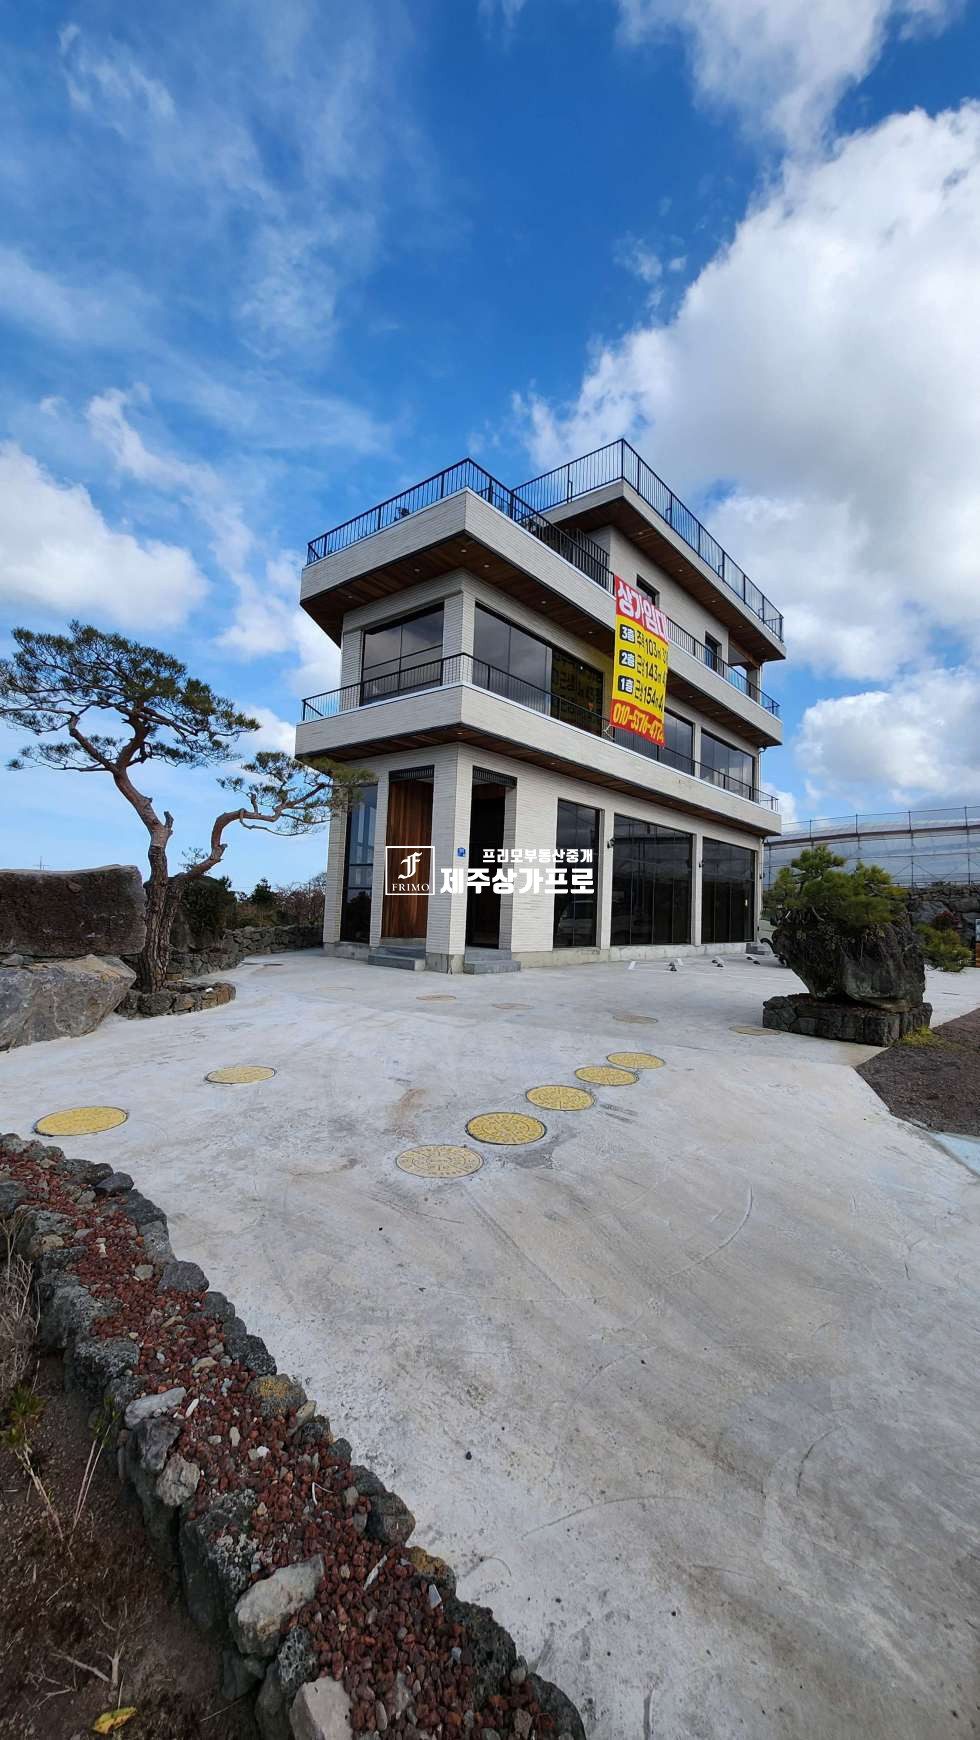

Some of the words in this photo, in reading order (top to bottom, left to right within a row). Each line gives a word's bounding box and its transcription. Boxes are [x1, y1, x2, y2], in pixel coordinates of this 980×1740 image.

[621, 625, 635, 644] 3층
[621, 651, 635, 668] 2층
[620, 677, 634, 694] 1층
